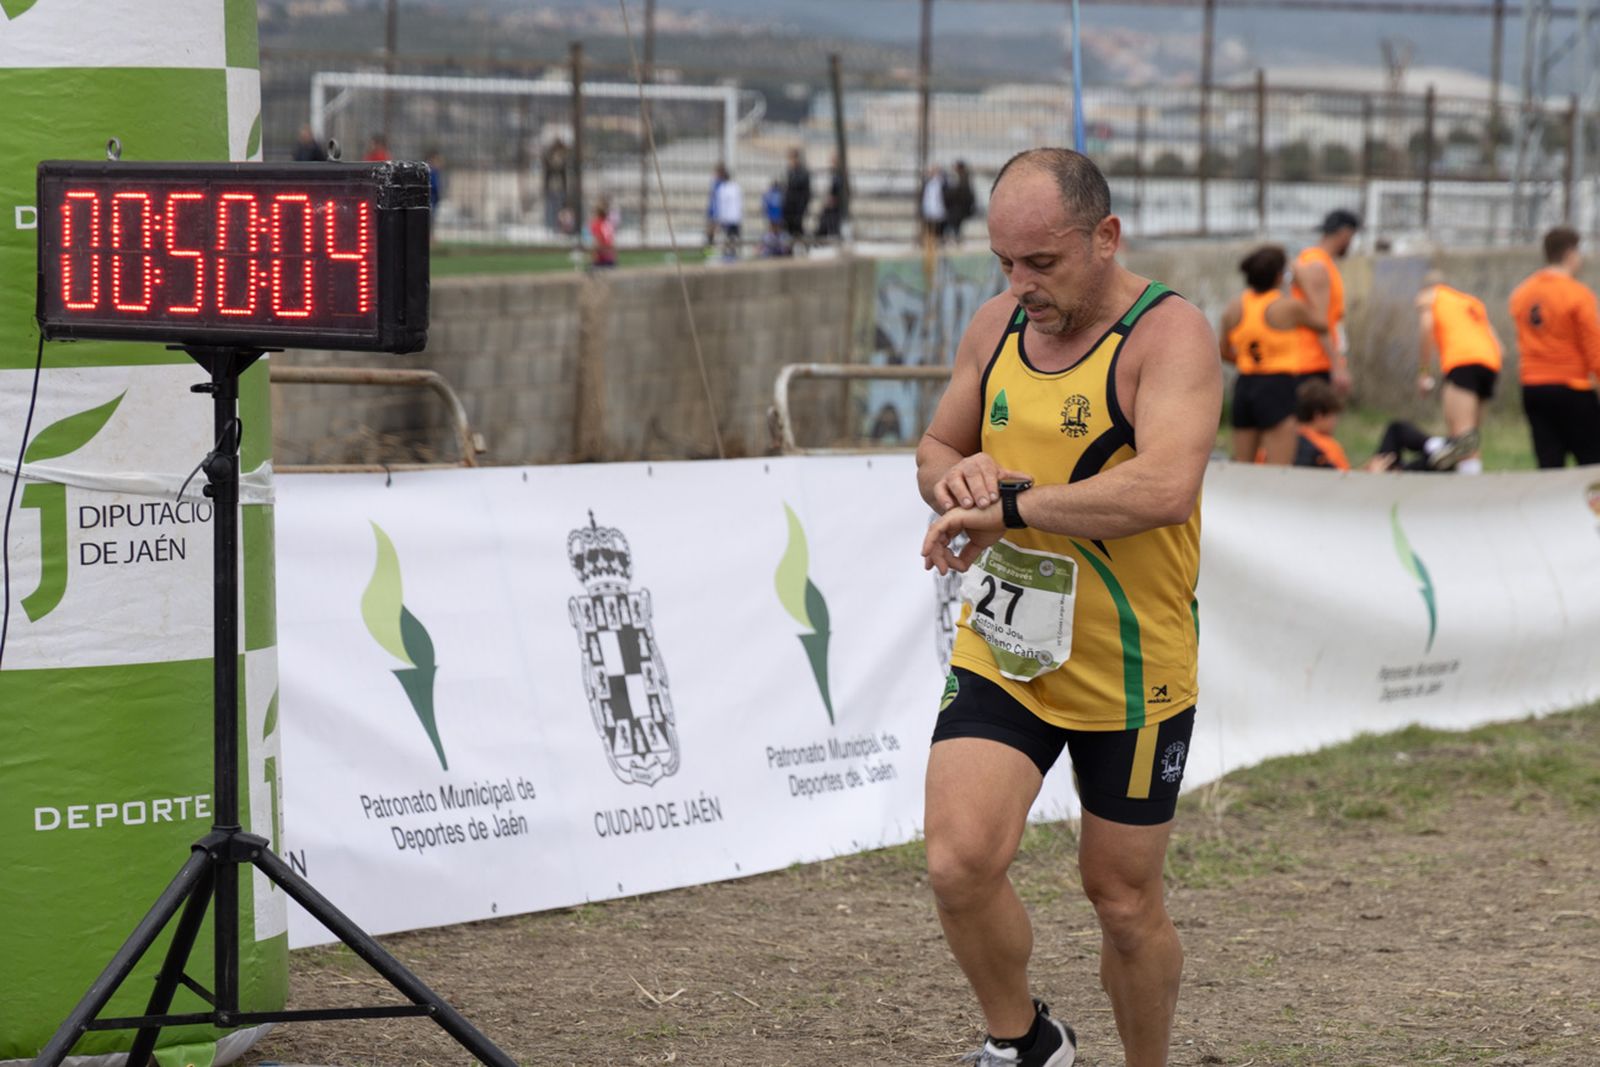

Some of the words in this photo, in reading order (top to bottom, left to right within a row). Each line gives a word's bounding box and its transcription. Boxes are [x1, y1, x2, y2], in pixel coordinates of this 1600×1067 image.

[61, 191, 367, 318] 00:50:04
[79, 500, 213, 529] DIPUTACIO
[80, 541, 117, 565] DE
[123, 534, 186, 564] JAÉN
[975, 574, 1024, 626] 27
[766, 742, 826, 768] Patronato
[360, 788, 438, 819] Patronato
[439, 779, 515, 810] Municipal
[516, 776, 536, 801] de
[788, 771, 844, 799] Deportes
[845, 767, 863, 788] de
[391, 819, 466, 855] Deportes
[468, 815, 489, 841] de
[492, 810, 528, 837] Jaén
[594, 805, 655, 838] CIUDAD
[656, 802, 680, 828] DE
[683, 791, 723, 826] JAÉN
